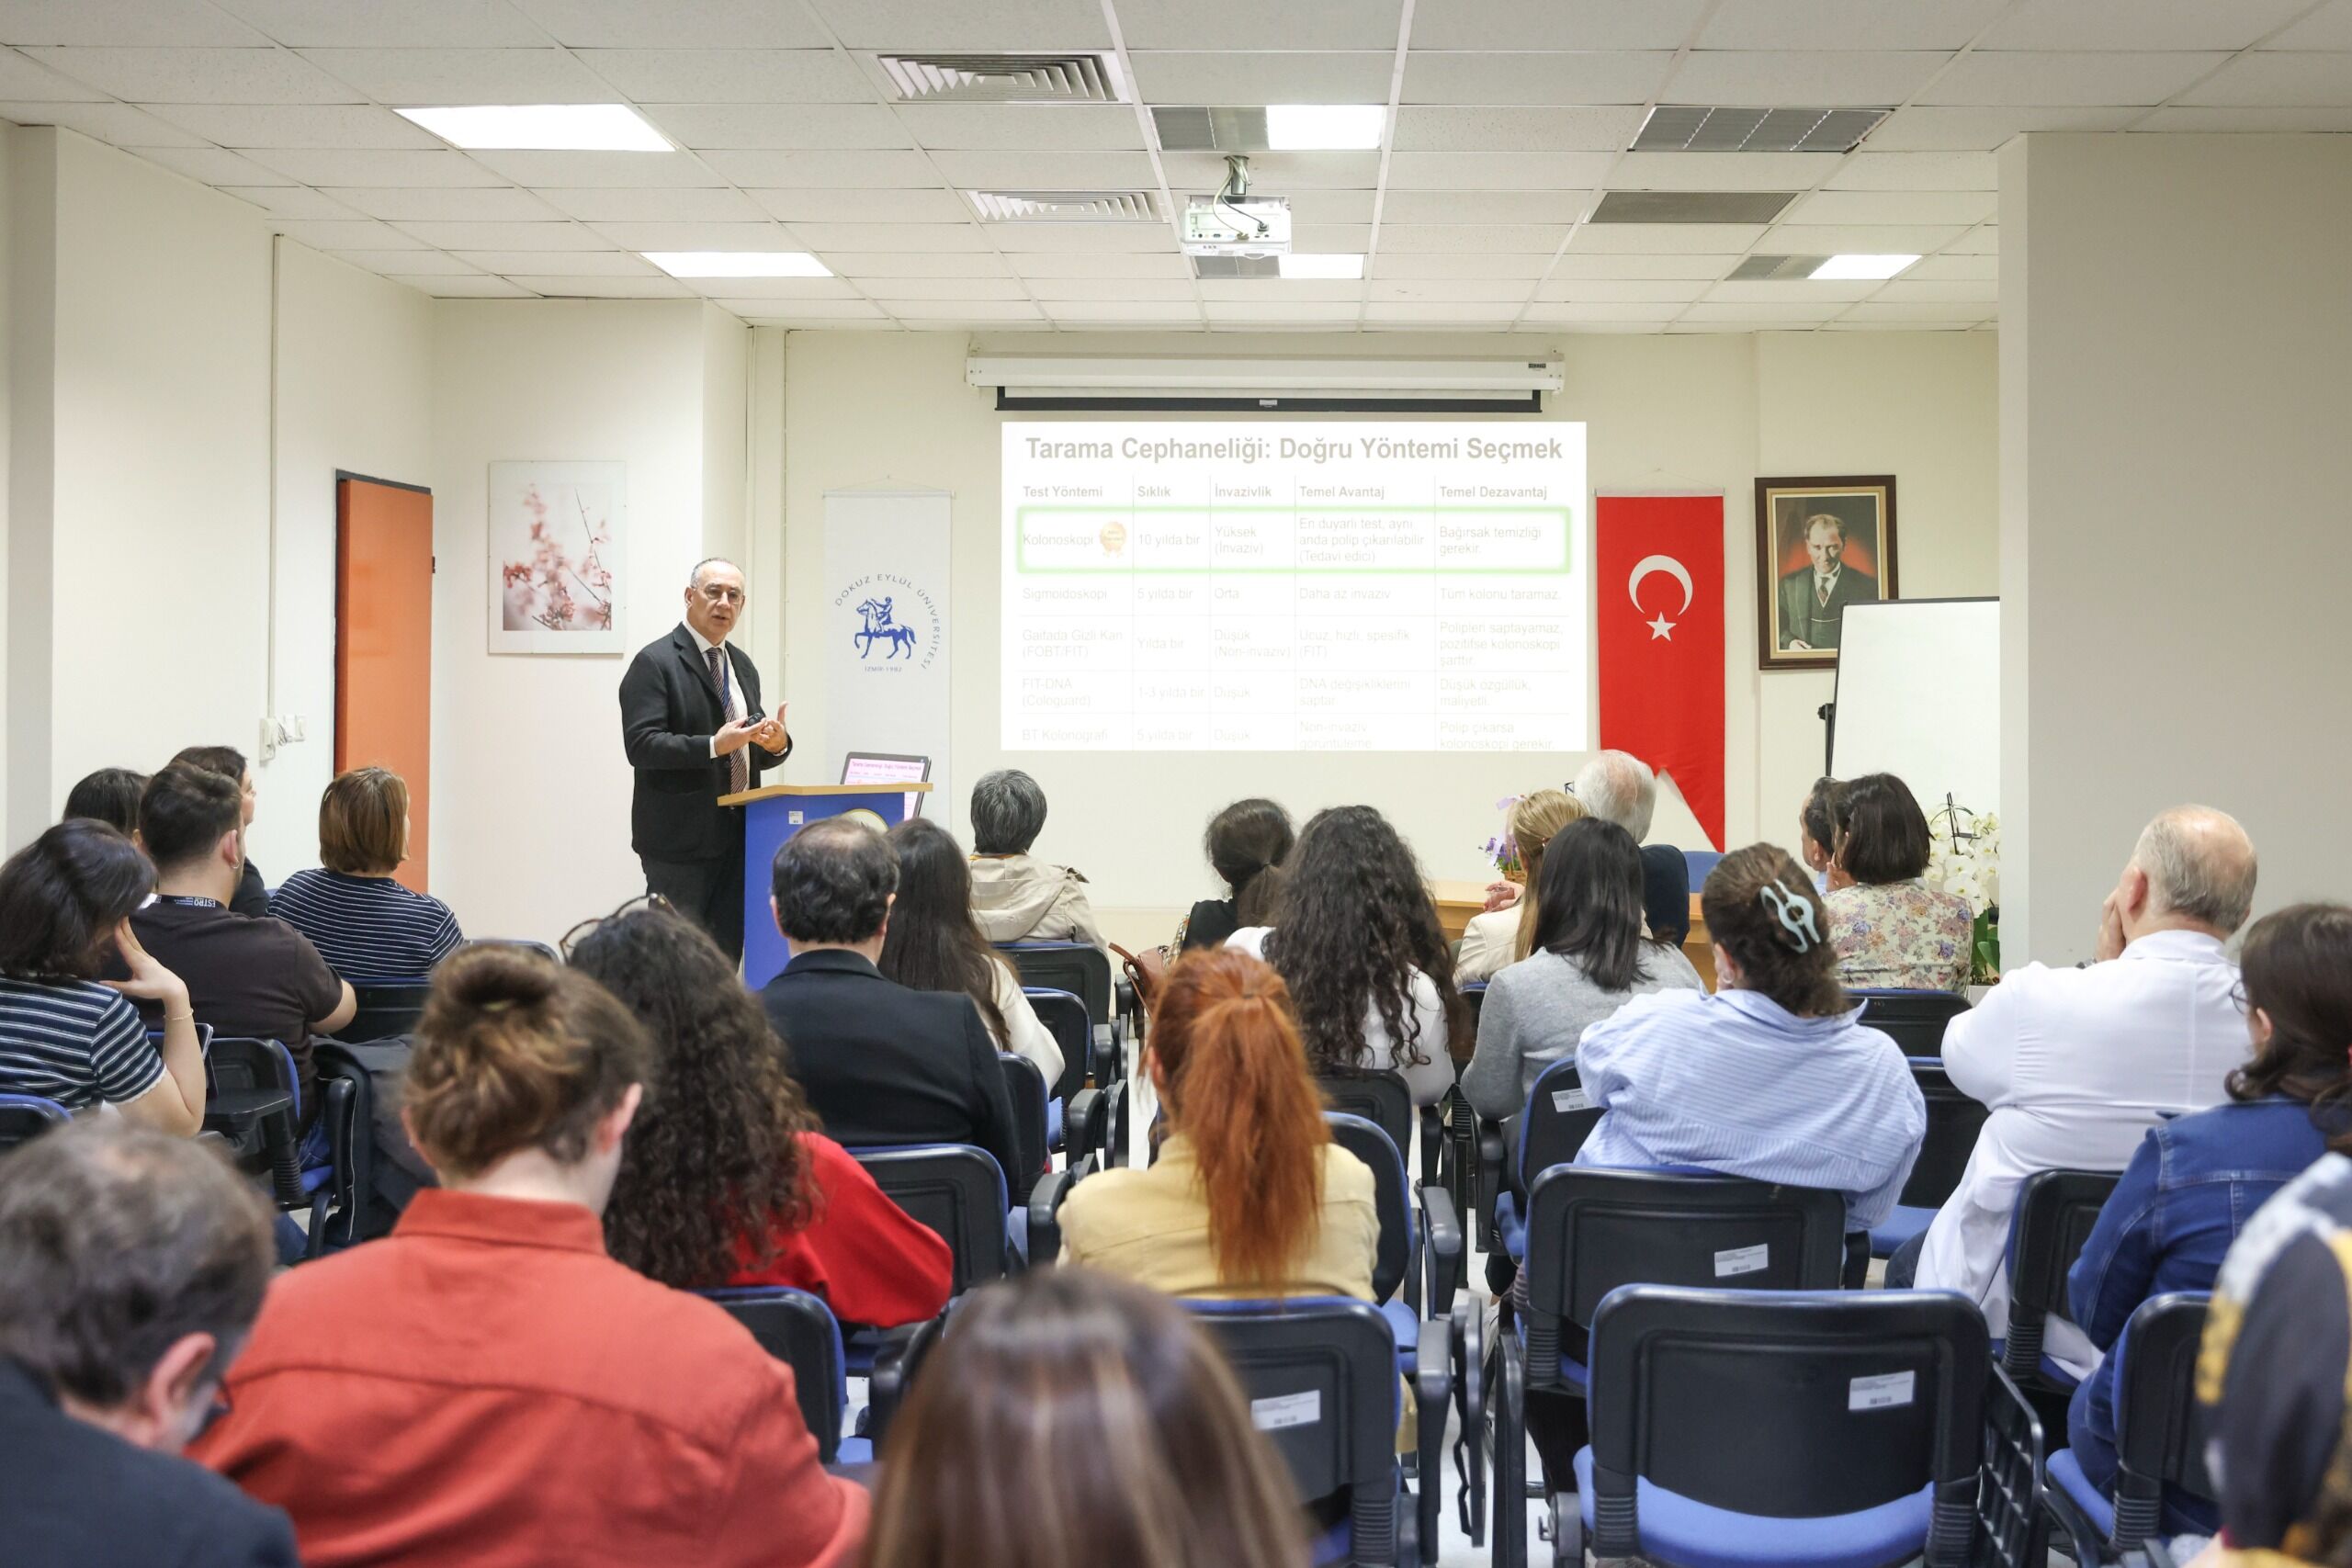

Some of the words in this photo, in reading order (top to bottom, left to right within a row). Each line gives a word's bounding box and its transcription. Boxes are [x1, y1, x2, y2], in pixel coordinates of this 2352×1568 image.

[1025, 437, 1114, 459] Tarama
[1122, 436, 1271, 465] Cephaneliği:
[1280, 436, 1352, 465] Doğru
[1360, 436, 1459, 459] Yöntemi
[1467, 436, 1564, 465] Seçmek
[1023, 486, 1048, 498] Test
[1052, 486, 1102, 498] Yöntemi
[1137, 486, 1171, 498] Sıklık
[1215, 483, 1272, 498] İnvazivlik
[1299, 486, 1335, 498] Temel
[1339, 486, 1385, 501] Avantaj
[1440, 486, 1476, 498] Temel
[1479, 486, 1547, 501] Dezavantaj
[1215, 526, 1257, 537] Yüksek
[1300, 518, 1315, 529] En
[1360, 519, 1385, 531] test,
[1440, 526, 1490, 540] Bağırsak
[1494, 526, 1542, 540] temizliği
[1023, 534, 1093, 548] Kolonoskopi
[1139, 534, 1151, 545] 10
[1154, 534, 1182, 548] yılda
[1185, 534, 1200, 546] bir
[1299, 535, 1329, 546] anda
[1331, 535, 1359, 548] polip
[1215, 541, 1264, 557] (İnvaziv)
[1440, 544, 1481, 558] gerekir.
[1299, 551, 1340, 563] (Tedavi
[1344, 551, 1375, 563] edici)
[834, 576, 871, 606] DOKUZ
[1023, 588, 1107, 603] Sigmoidoskopi
[1137, 588, 1144, 599] 5
[1147, 588, 1175, 603] yılda
[1179, 588, 1193, 600] bir
[1214, 589, 1239, 600] Orta
[1299, 588, 1330, 600] Daha
[1334, 591, 1347, 600] az
[1351, 588, 1391, 600] invaziv
[1441, 588, 1464, 600] Tüm
[1469, 588, 1507, 600] kolonu
[1214, 629, 1250, 644] Düşük
[1440, 622, 1486, 637] Polipleri
[1170, 637, 1183, 649] bir
[1491, 638, 1560, 654] kolonoskopi
[1299, 646, 1328, 660] (FIT)
[1023, 678, 1072, 690] FIT-DNA
[1299, 678, 1327, 690] DNA
[1440, 678, 1476, 694] Düşük
[1022, 729, 1037, 740] BT
[1136, 729, 1144, 740] 5
[1440, 721, 1469, 736] Polip
[193, 897, 216, 908] ESTRO
